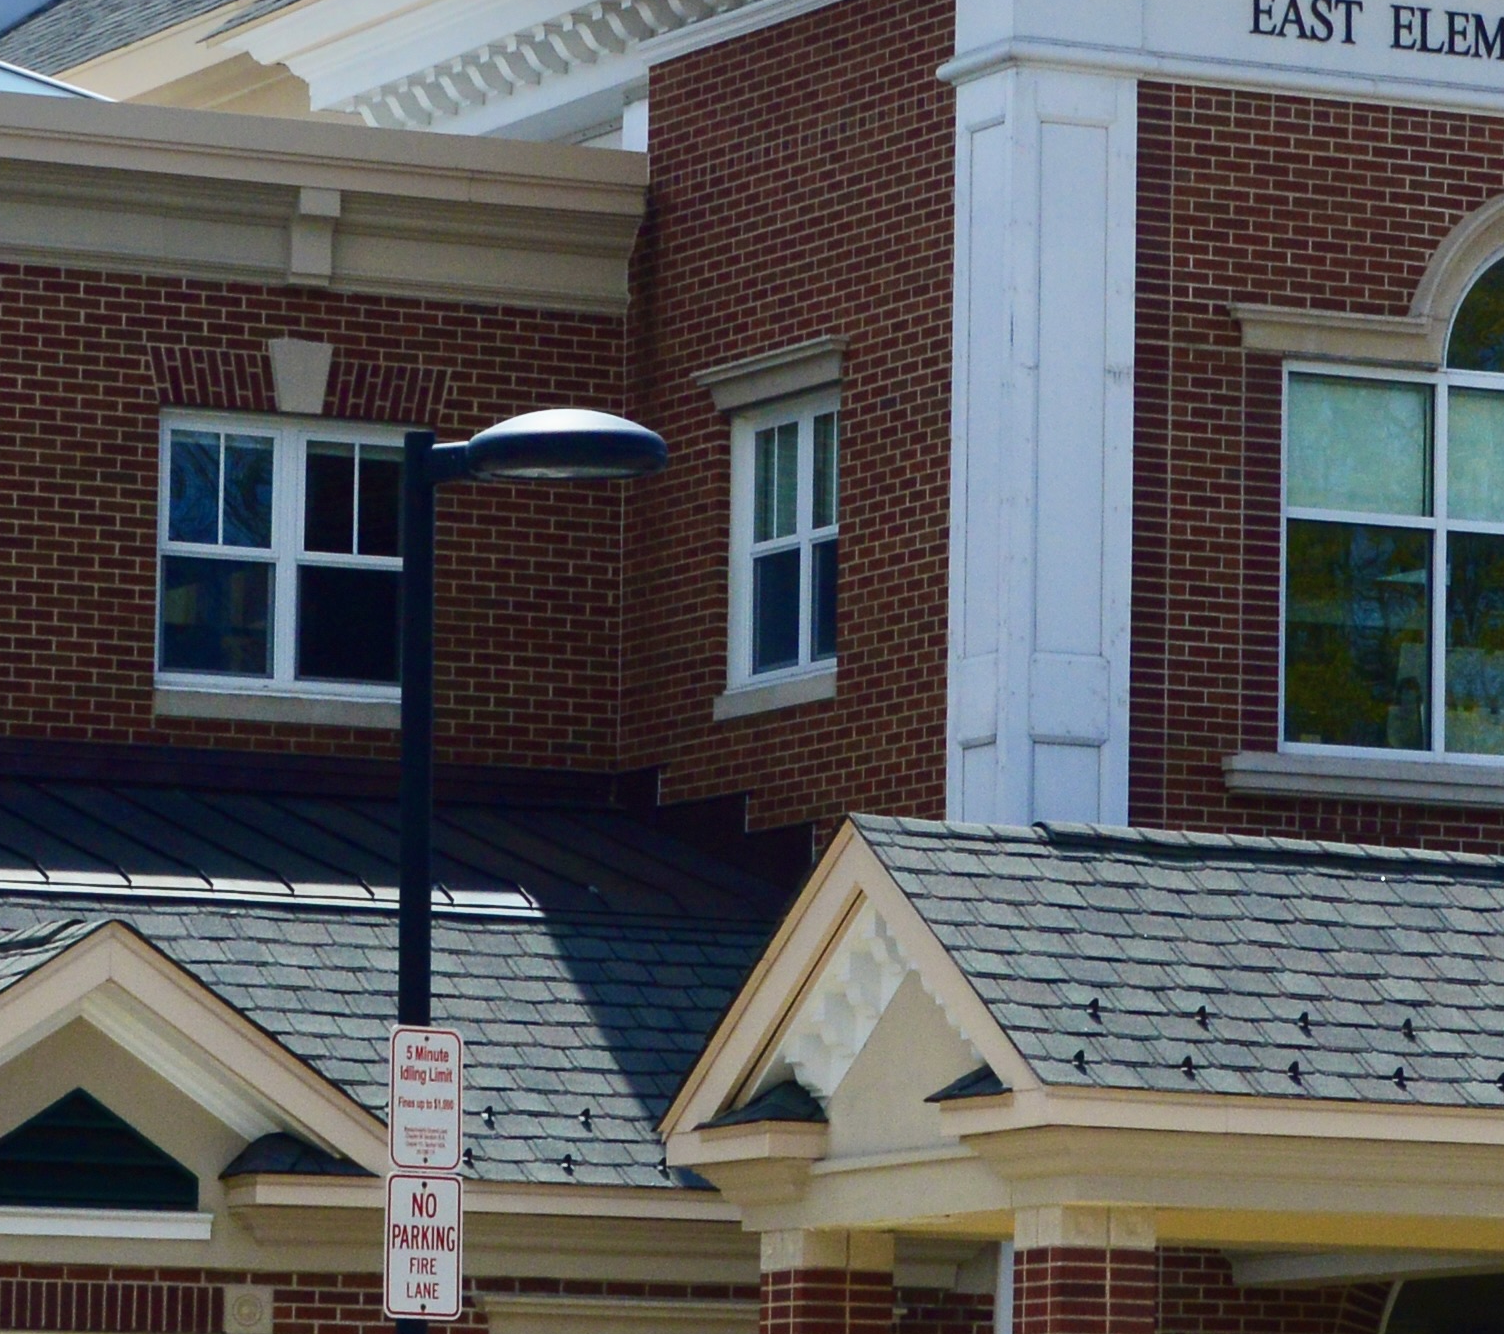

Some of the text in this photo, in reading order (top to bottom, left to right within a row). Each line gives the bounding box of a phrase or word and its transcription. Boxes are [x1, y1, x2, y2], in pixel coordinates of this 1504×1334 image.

[407, 1045, 449, 1063] 5 Minute
[400, 1065, 453, 1085] Idling Limit
[398, 1096, 415, 1108] Fines
[416, 1100, 425, 1111] up
[426, 1099, 433, 1110] to
[411, 1192, 437, 1218] NO
[392, 1224, 455, 1252] PARKING
[409, 1256, 437, 1276] FIRE
[406, 1282, 439, 1299] LANE
